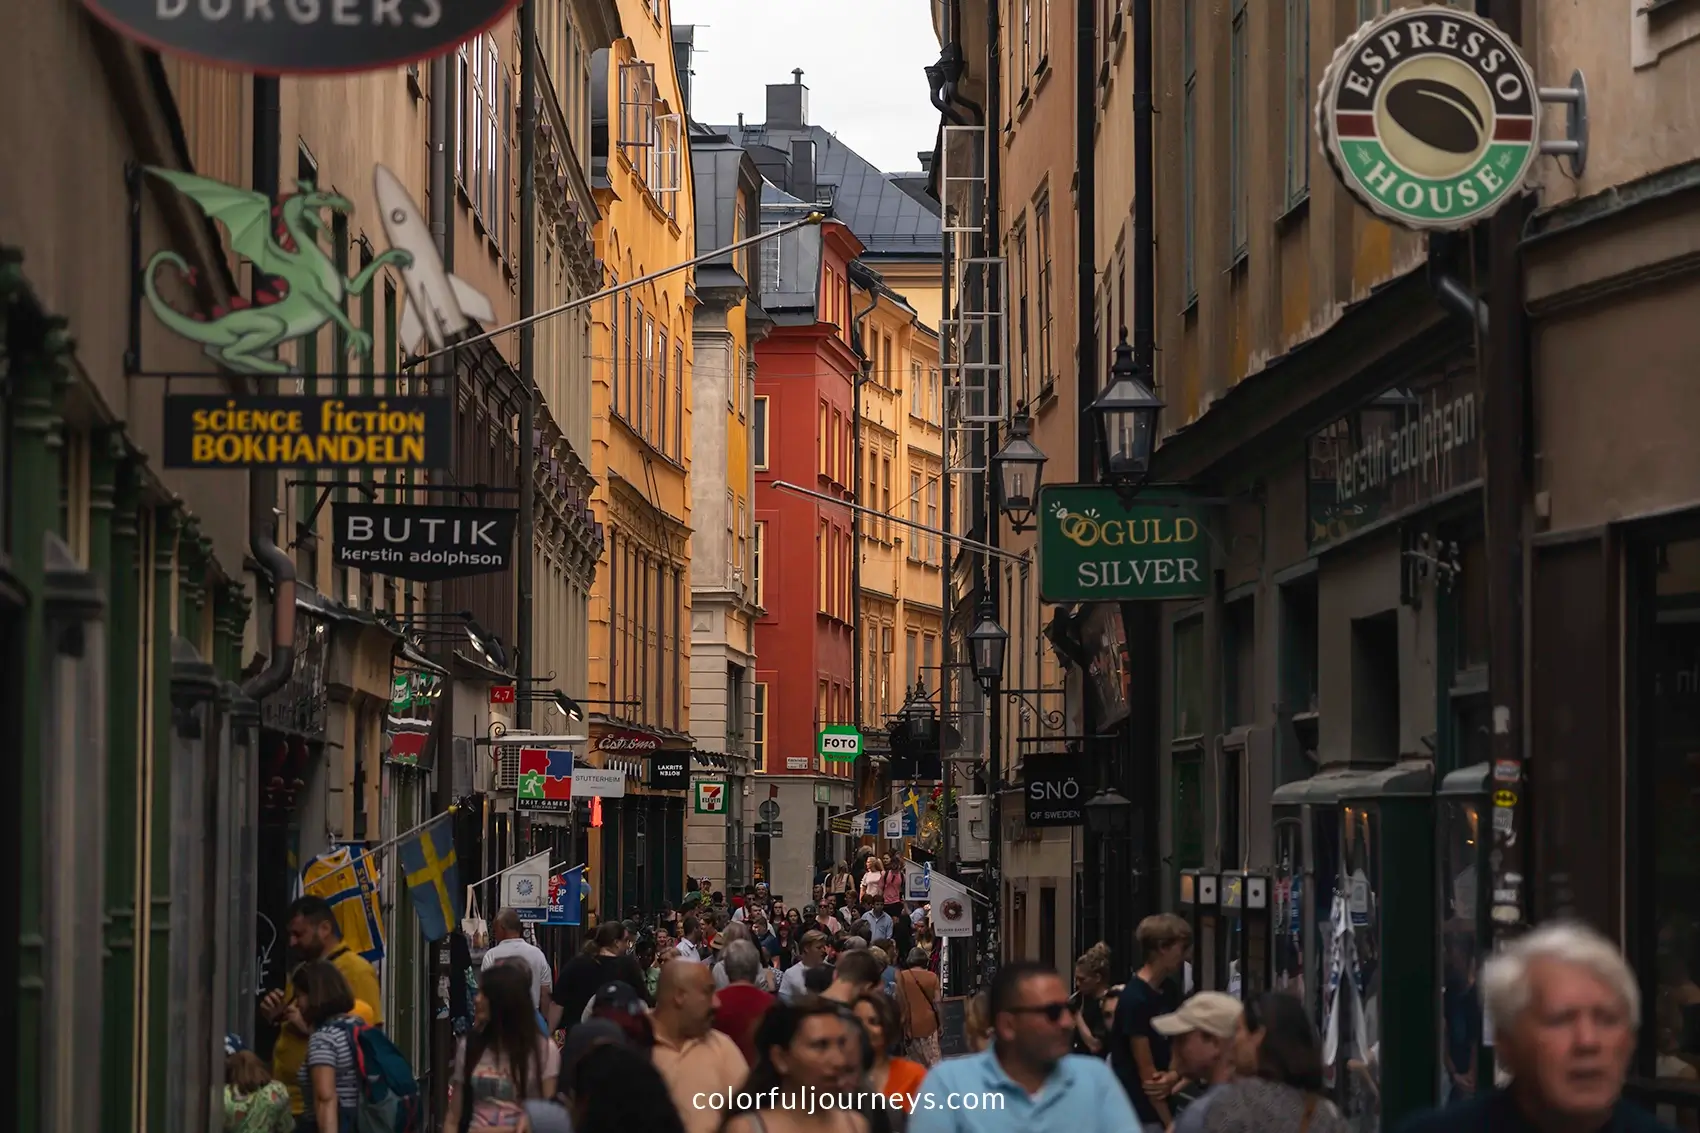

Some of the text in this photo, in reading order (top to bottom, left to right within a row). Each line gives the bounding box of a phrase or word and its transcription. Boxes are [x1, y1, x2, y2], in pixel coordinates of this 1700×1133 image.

[1344, 20, 1523, 101] ESPRESSO
[1364, 163, 1503, 213] HOUSE
[191, 433, 425, 462] BOKHANDELN
[1335, 388, 1475, 504] kerstin adolphson
[347, 516, 498, 546] BUTIK
[1100, 517, 1199, 546] GULD
[341, 547, 503, 566] kerstin adolphson
[1077, 558, 1202, 588] SILVER
[824, 738, 857, 749] FOTO
[575, 775, 621, 783] STUTTERHEIM
[1030, 777, 1079, 800] SNÖ
[1030, 810, 1081, 820] OF SWEDEN
